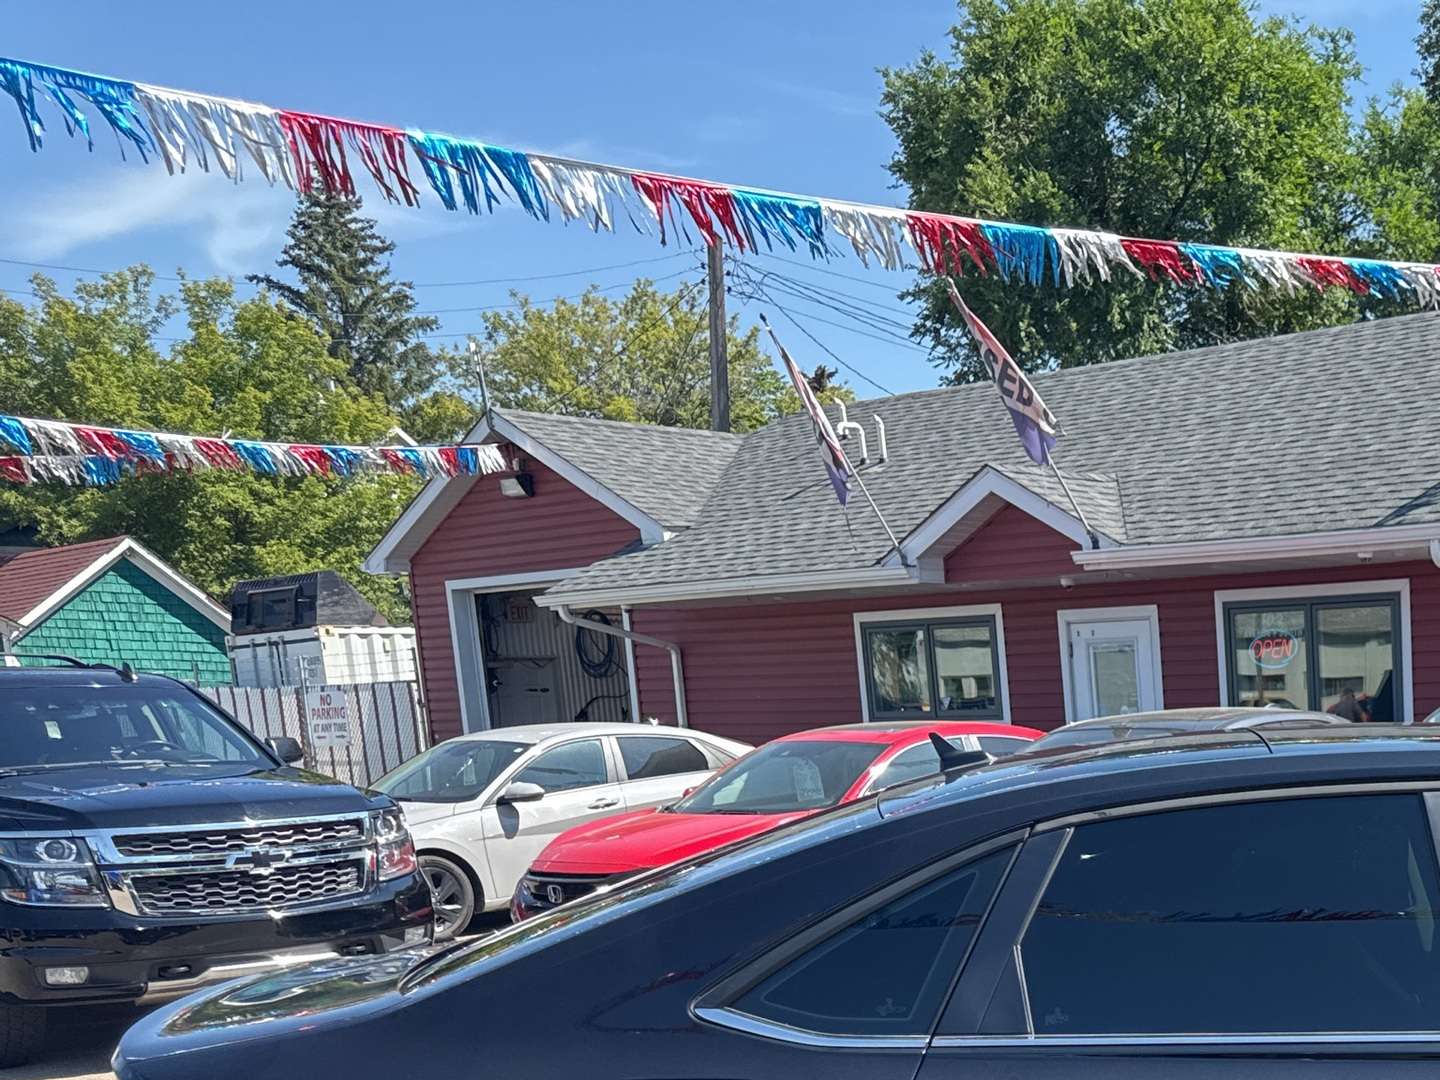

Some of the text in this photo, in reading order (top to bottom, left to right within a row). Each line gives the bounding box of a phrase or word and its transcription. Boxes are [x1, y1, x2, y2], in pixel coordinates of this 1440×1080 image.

[976, 338, 1034, 407] SED
[1252, 639, 1294, 659] OPEN
[319, 694, 332, 706] NO
[311, 707, 346, 721] PARKING
[313, 722, 347, 733] AT ANY TIME
